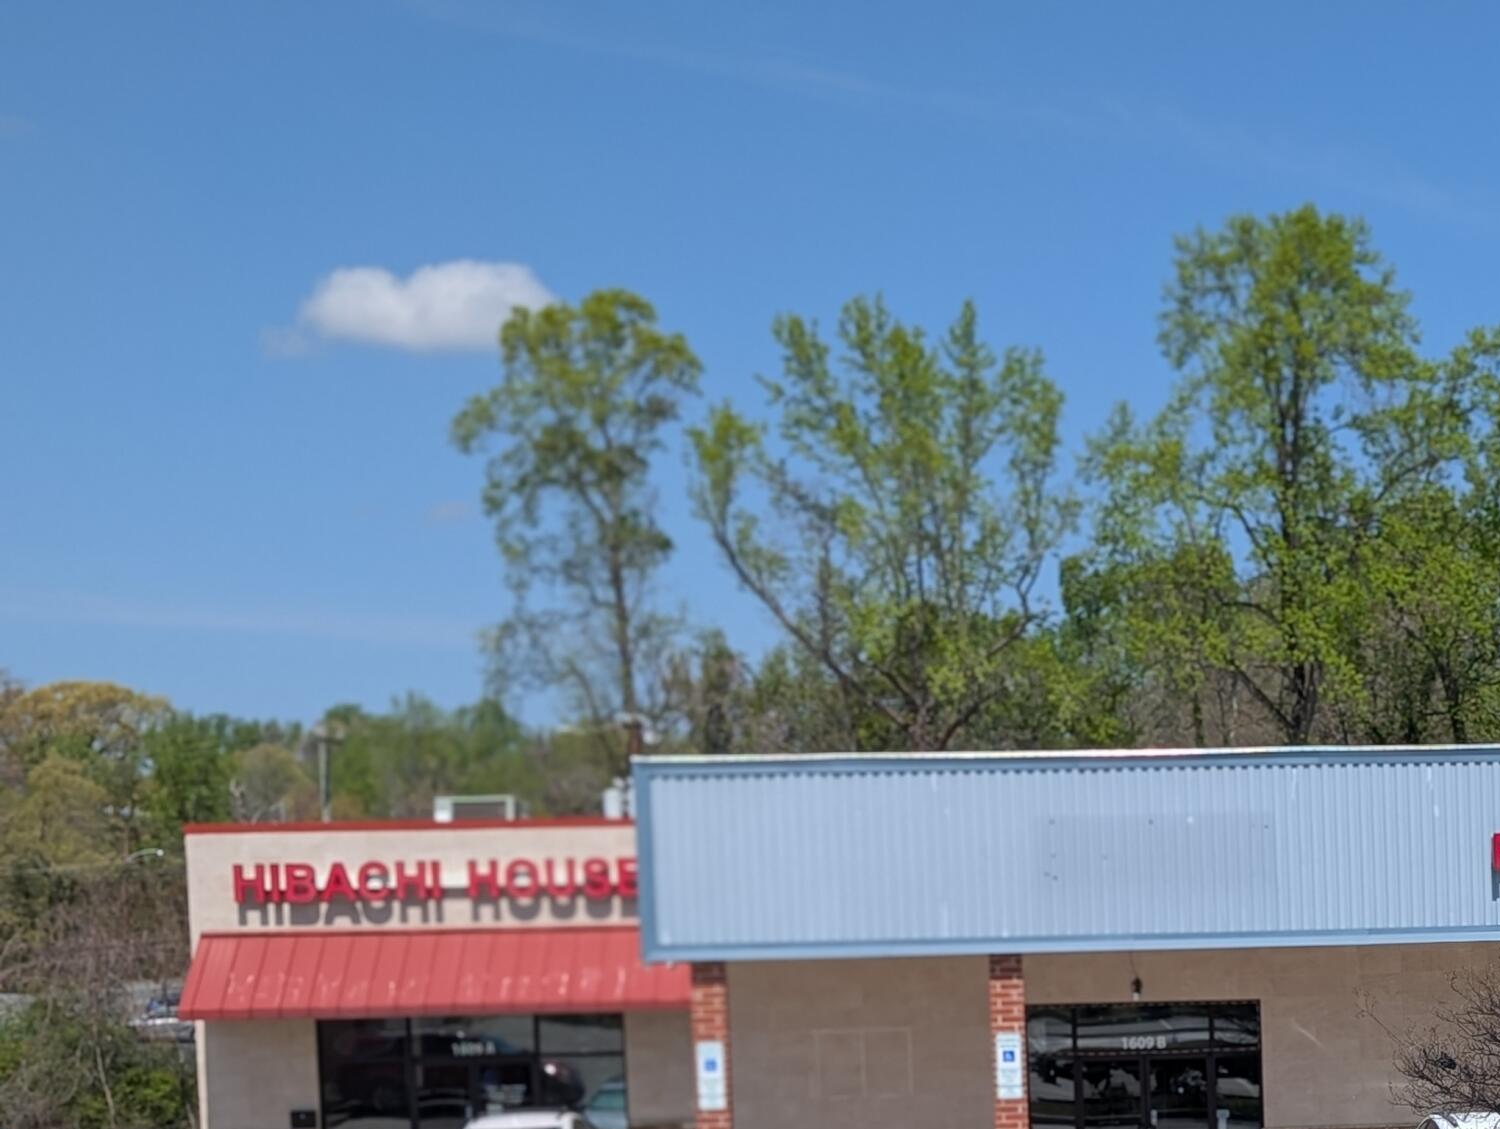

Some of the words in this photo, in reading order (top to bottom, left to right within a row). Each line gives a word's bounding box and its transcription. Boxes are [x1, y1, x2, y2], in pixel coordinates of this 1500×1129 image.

[232, 858, 443, 904] HIBACHI
[467, 856, 638, 900] HOUSE
[1121, 1036, 1155, 1050] 1609
[1156, 1036, 1167, 1050] B
